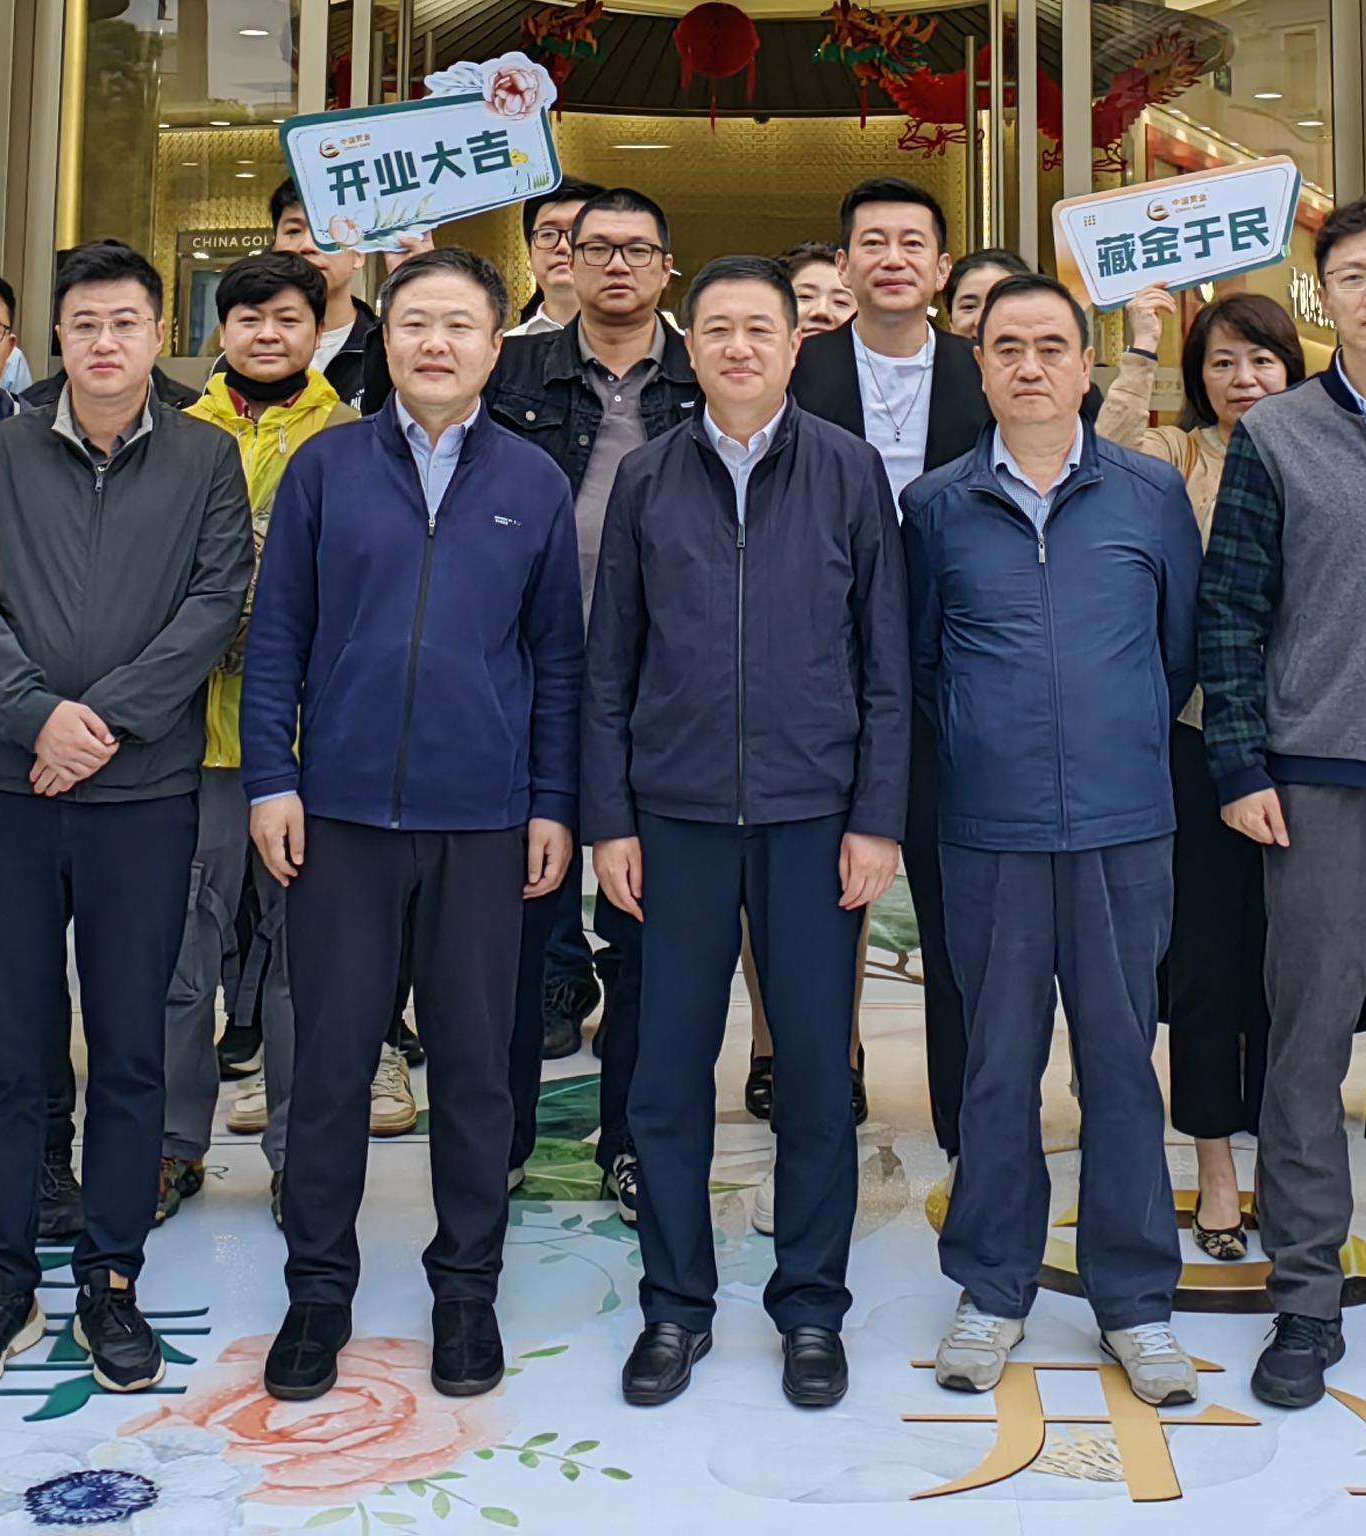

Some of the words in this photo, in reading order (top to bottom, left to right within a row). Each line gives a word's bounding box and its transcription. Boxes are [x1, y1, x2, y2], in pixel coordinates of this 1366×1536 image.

[326, 129, 513, 206] 开业大吉
[192, 236, 239, 248] CHINA
[241, 235, 271, 246] GOL
[1095, 206, 1271, 278] 藏金于民
